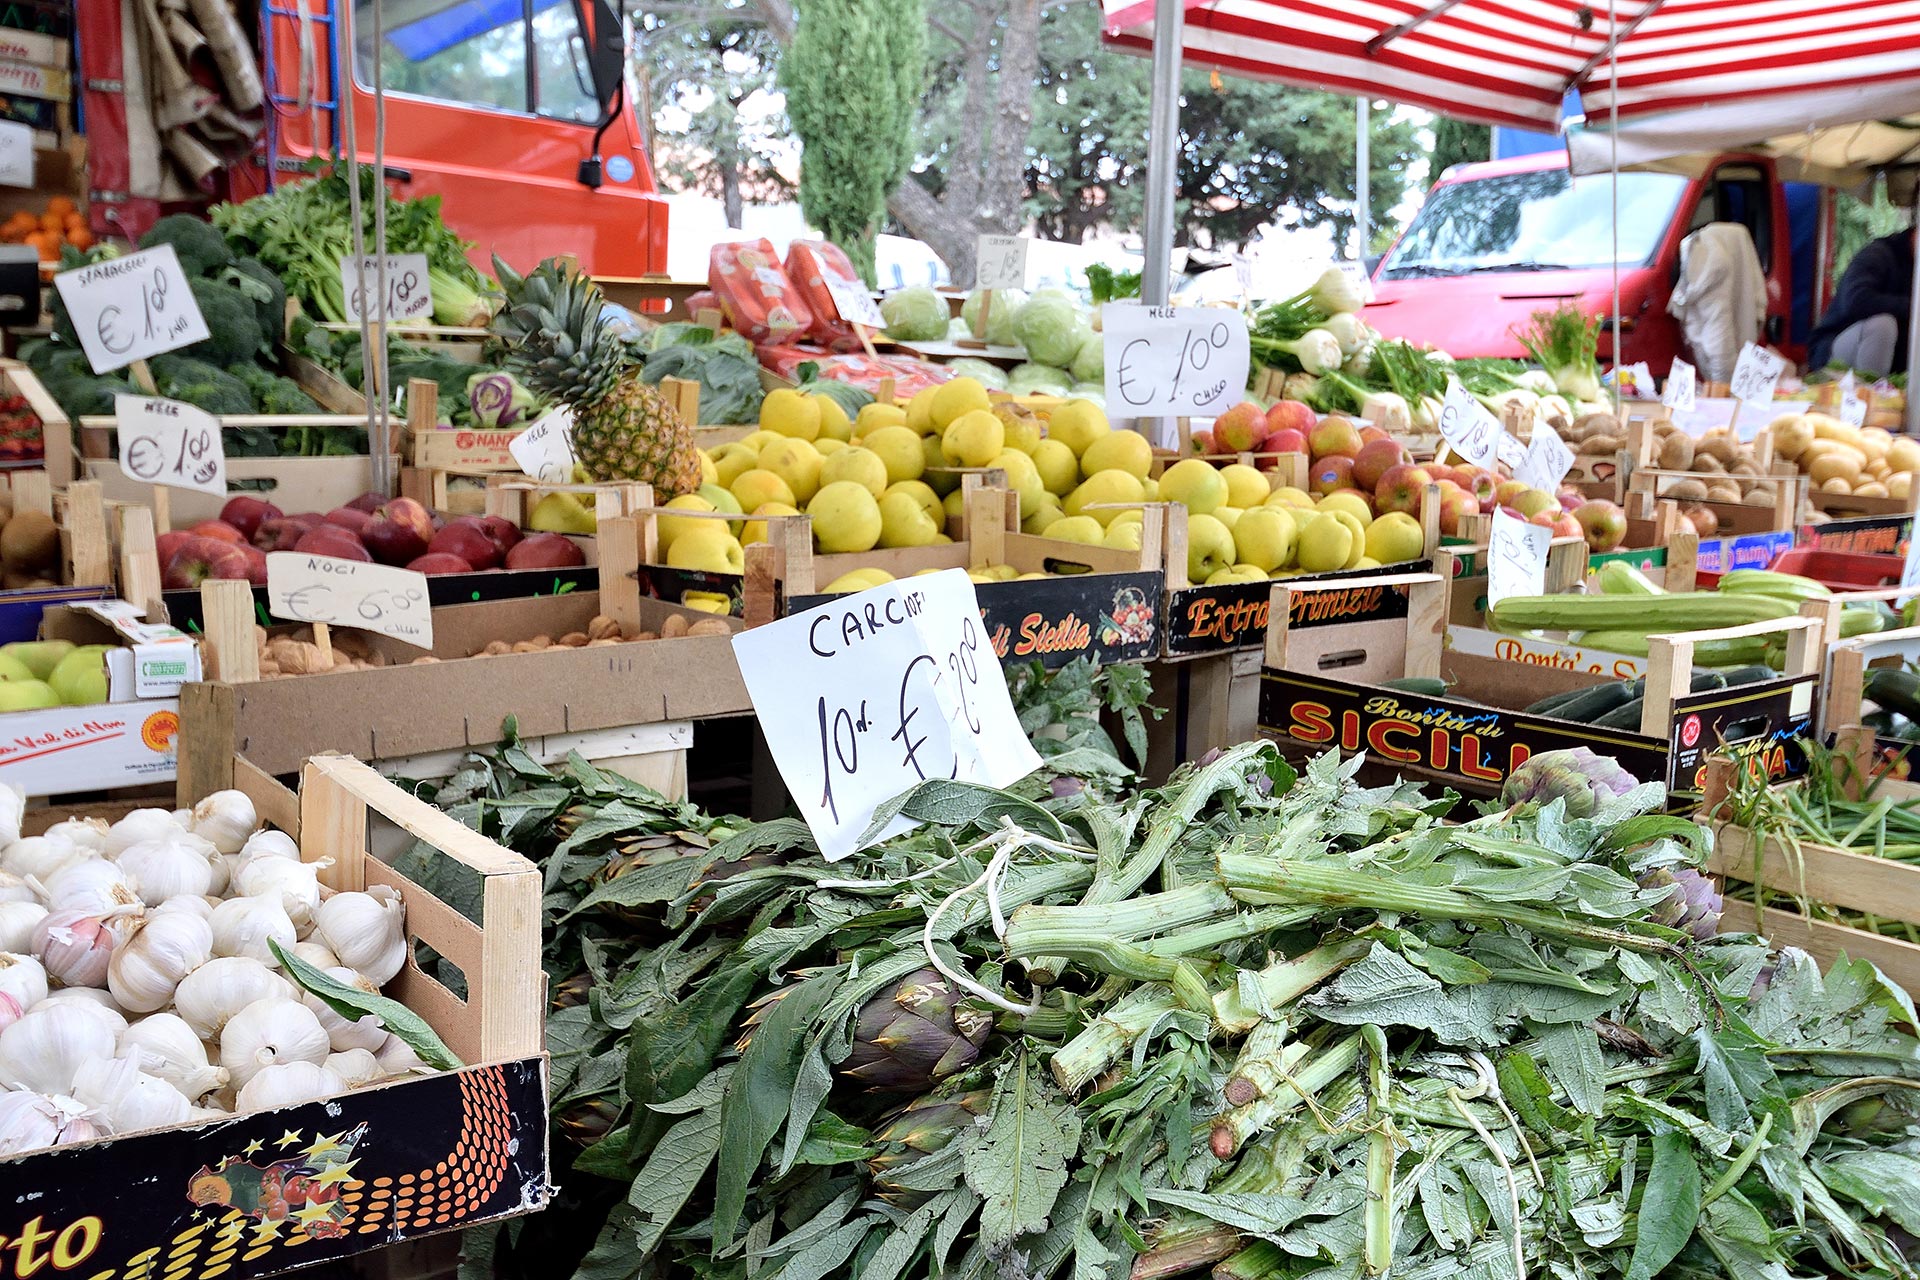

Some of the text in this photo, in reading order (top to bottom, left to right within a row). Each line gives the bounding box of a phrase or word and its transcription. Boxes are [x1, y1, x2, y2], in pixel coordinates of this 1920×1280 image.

[97, 304, 135, 354] €
[1149, 307, 1176, 318] MELE
[1117, 339, 1156, 405] €
[128, 436, 164, 479] €
[307, 558, 356, 575] NOCI
[281, 584, 336, 622] €
[1187, 597, 1269, 643] Extra
[1014, 612, 1092, 656] Sicilia
[1475, 723, 1505, 738] di
